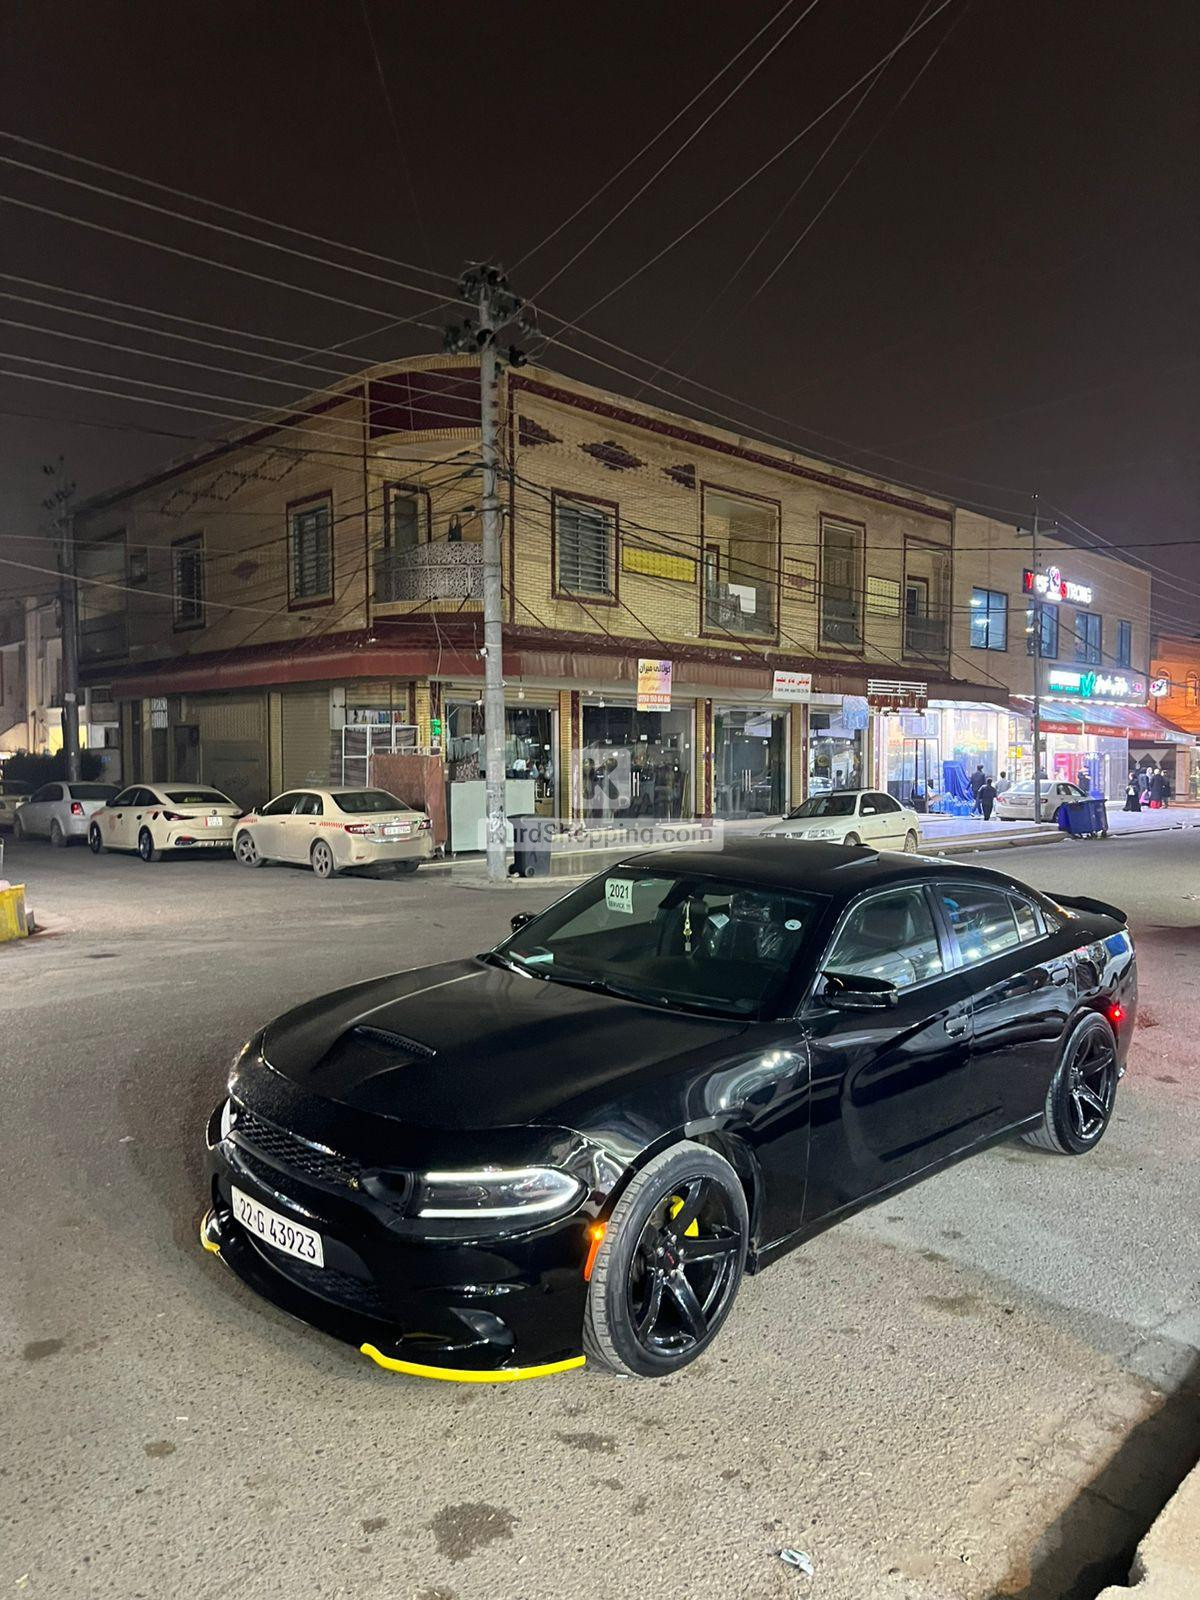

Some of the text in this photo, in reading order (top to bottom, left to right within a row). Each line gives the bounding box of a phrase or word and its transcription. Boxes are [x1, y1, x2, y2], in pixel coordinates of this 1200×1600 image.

[1060, 580, 1092, 604] STRONG
[610, 883, 629, 899] 2021
[270, 1218, 316, 1259] 43923
